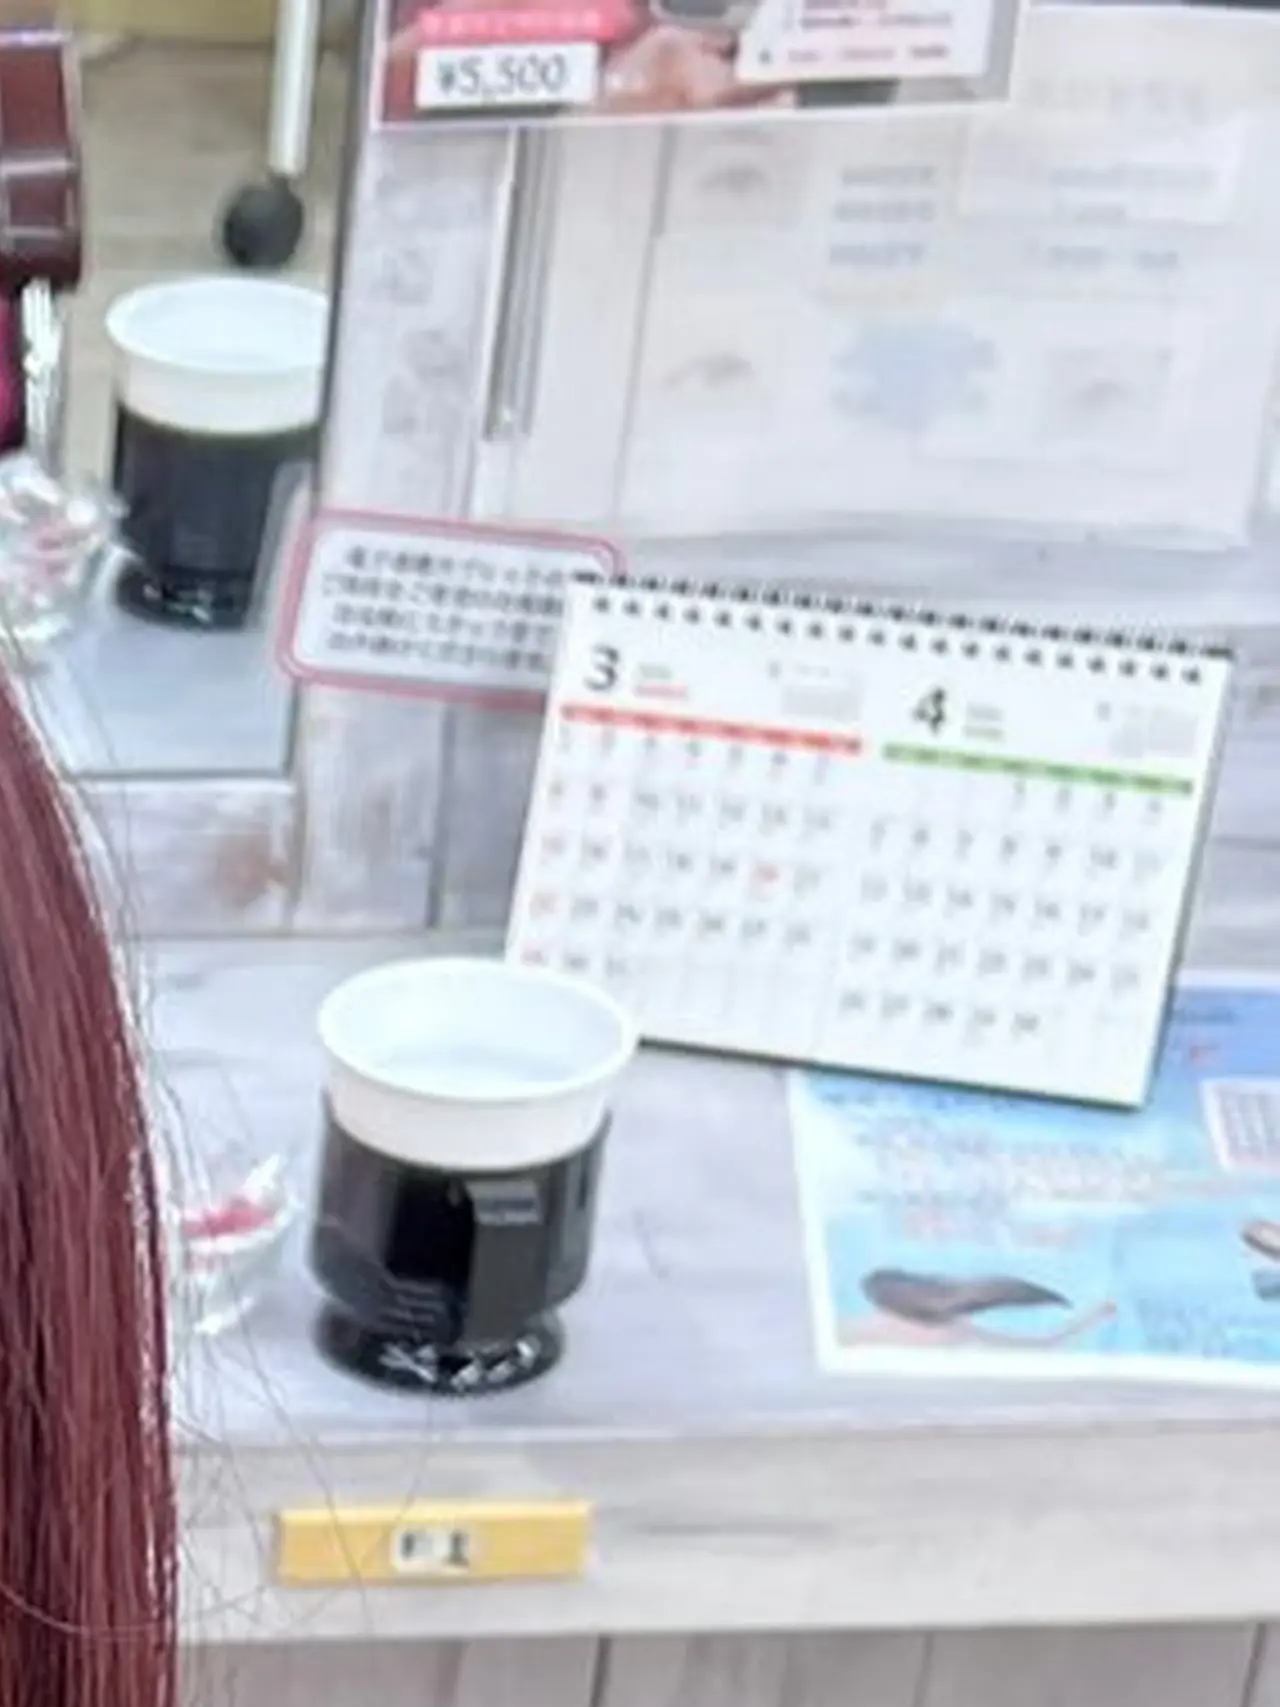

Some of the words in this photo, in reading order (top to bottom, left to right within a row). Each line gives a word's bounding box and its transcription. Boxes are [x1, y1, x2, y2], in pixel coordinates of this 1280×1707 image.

[437, 53, 566, 100] ¥5,500
[583, 643, 620, 693] 3
[912, 686, 945, 736] 4
